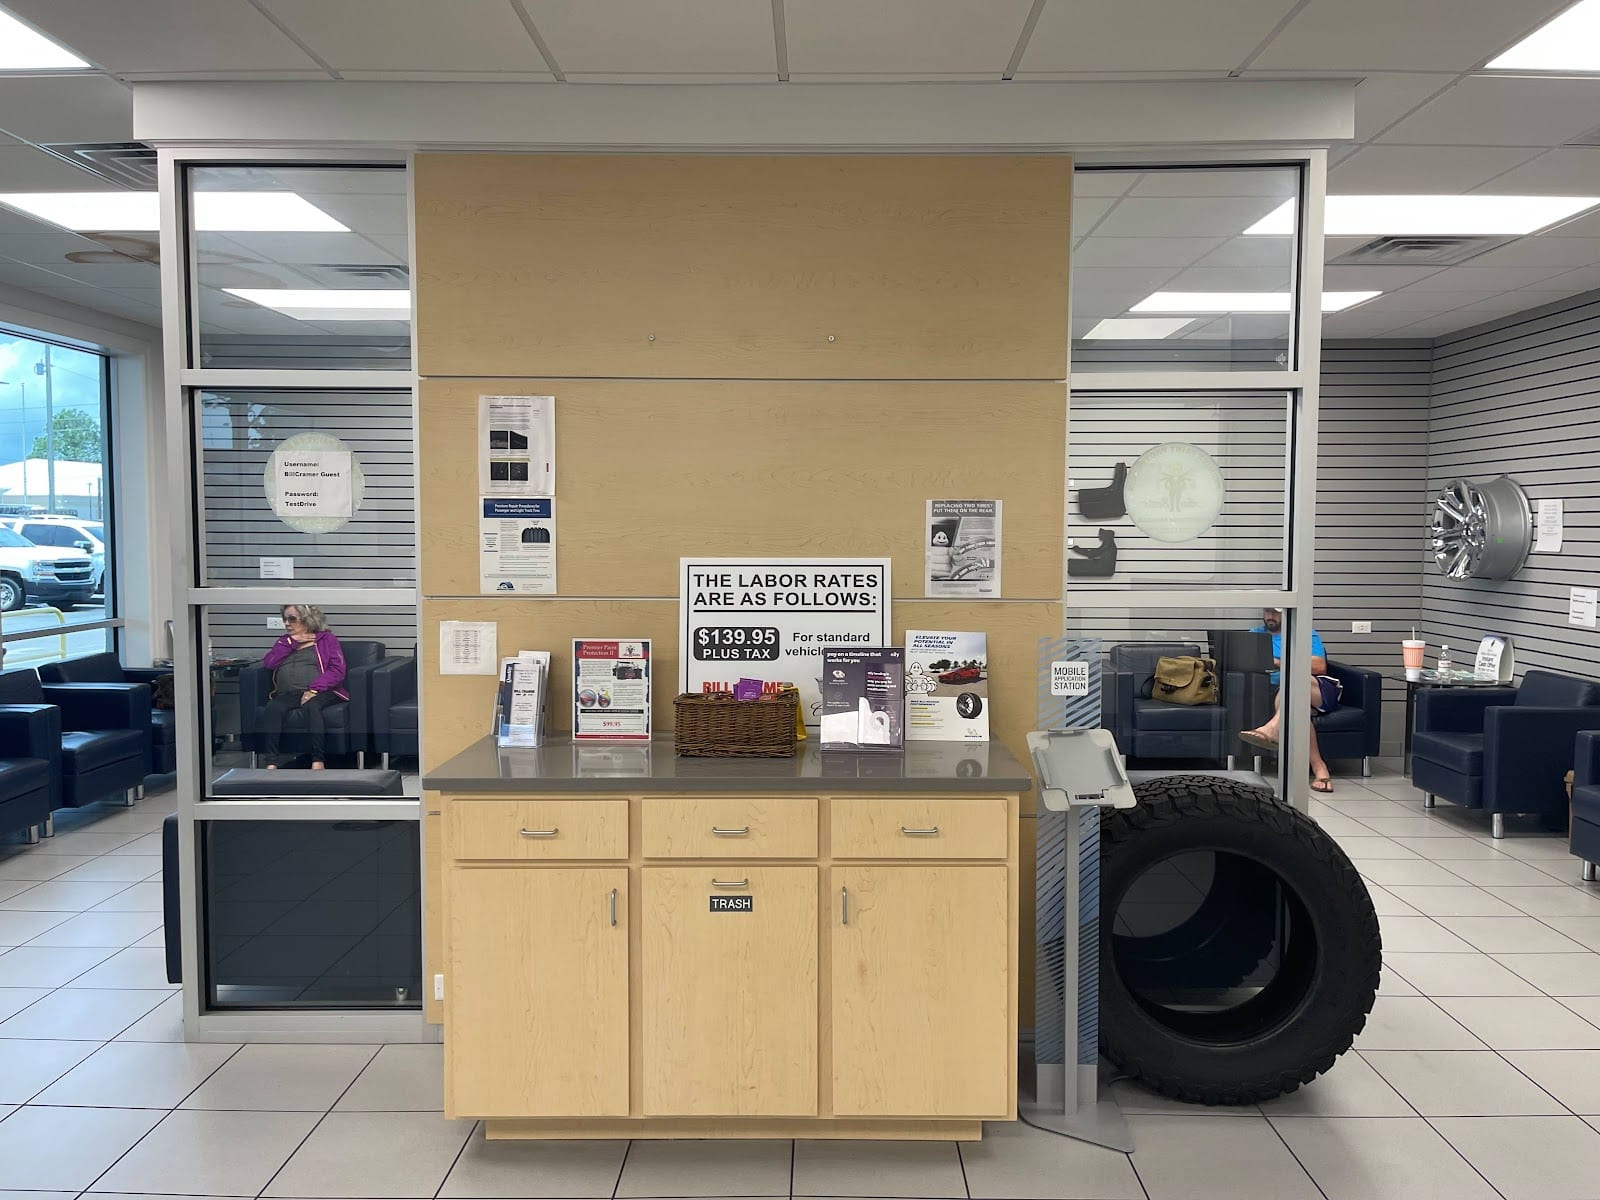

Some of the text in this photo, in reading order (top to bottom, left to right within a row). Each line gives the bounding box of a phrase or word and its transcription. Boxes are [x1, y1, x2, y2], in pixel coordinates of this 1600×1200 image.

[693, 574, 878, 588] THE LABOR RATES
[693, 592, 877, 606] ARE AS FOLLOWS:
[698, 628, 776, 646] $139.95
[793, 632, 870, 642] For standard
[703, 648, 771, 659] PLUS TAX
[1054, 667, 1086, 676] MOBILE
[1054, 682, 1086, 690] STATION
[711, 899, 751, 909] TRASH
